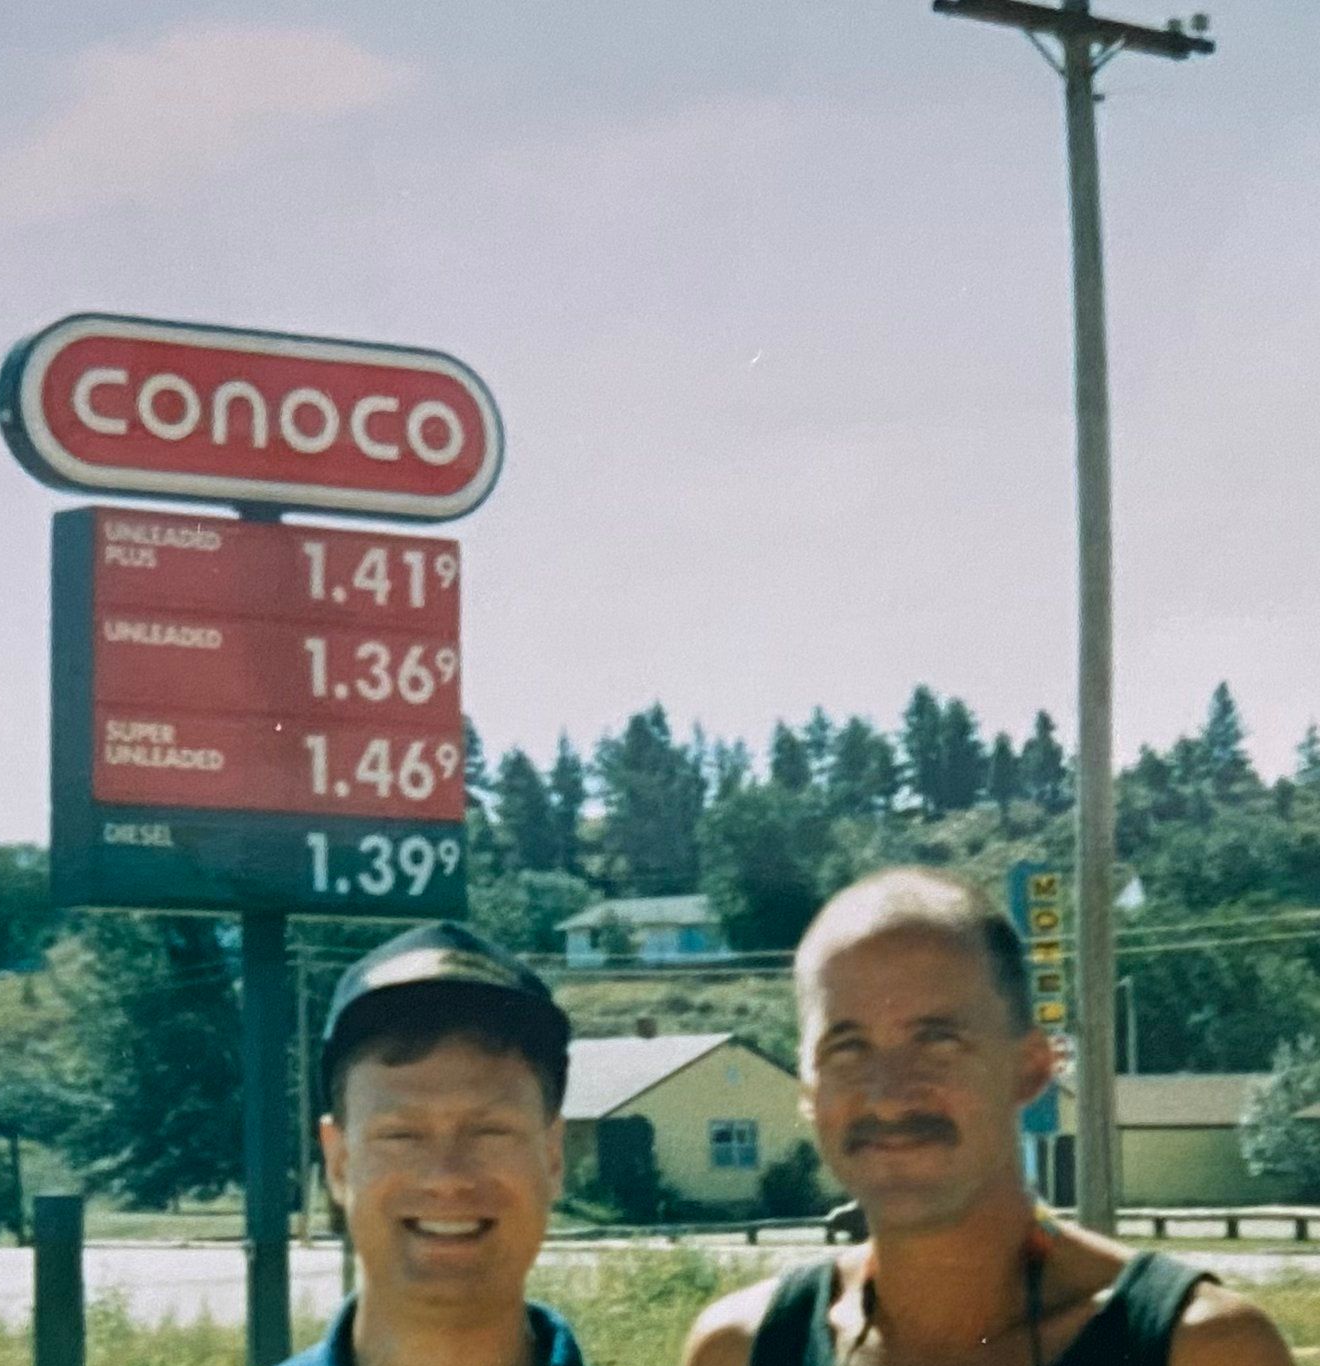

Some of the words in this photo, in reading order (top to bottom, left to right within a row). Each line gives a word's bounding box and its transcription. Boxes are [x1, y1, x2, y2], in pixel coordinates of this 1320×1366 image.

[73, 368, 465, 465] CONOCO
[104, 520, 222, 550] UNLEADED
[104, 545, 158, 569] PLUS
[104, 620, 223, 649] UNLEADED
[106, 719, 175, 744] SUPER
[105, 742, 225, 771] UNLEADED
[104, 823, 175, 847] DIESEL
